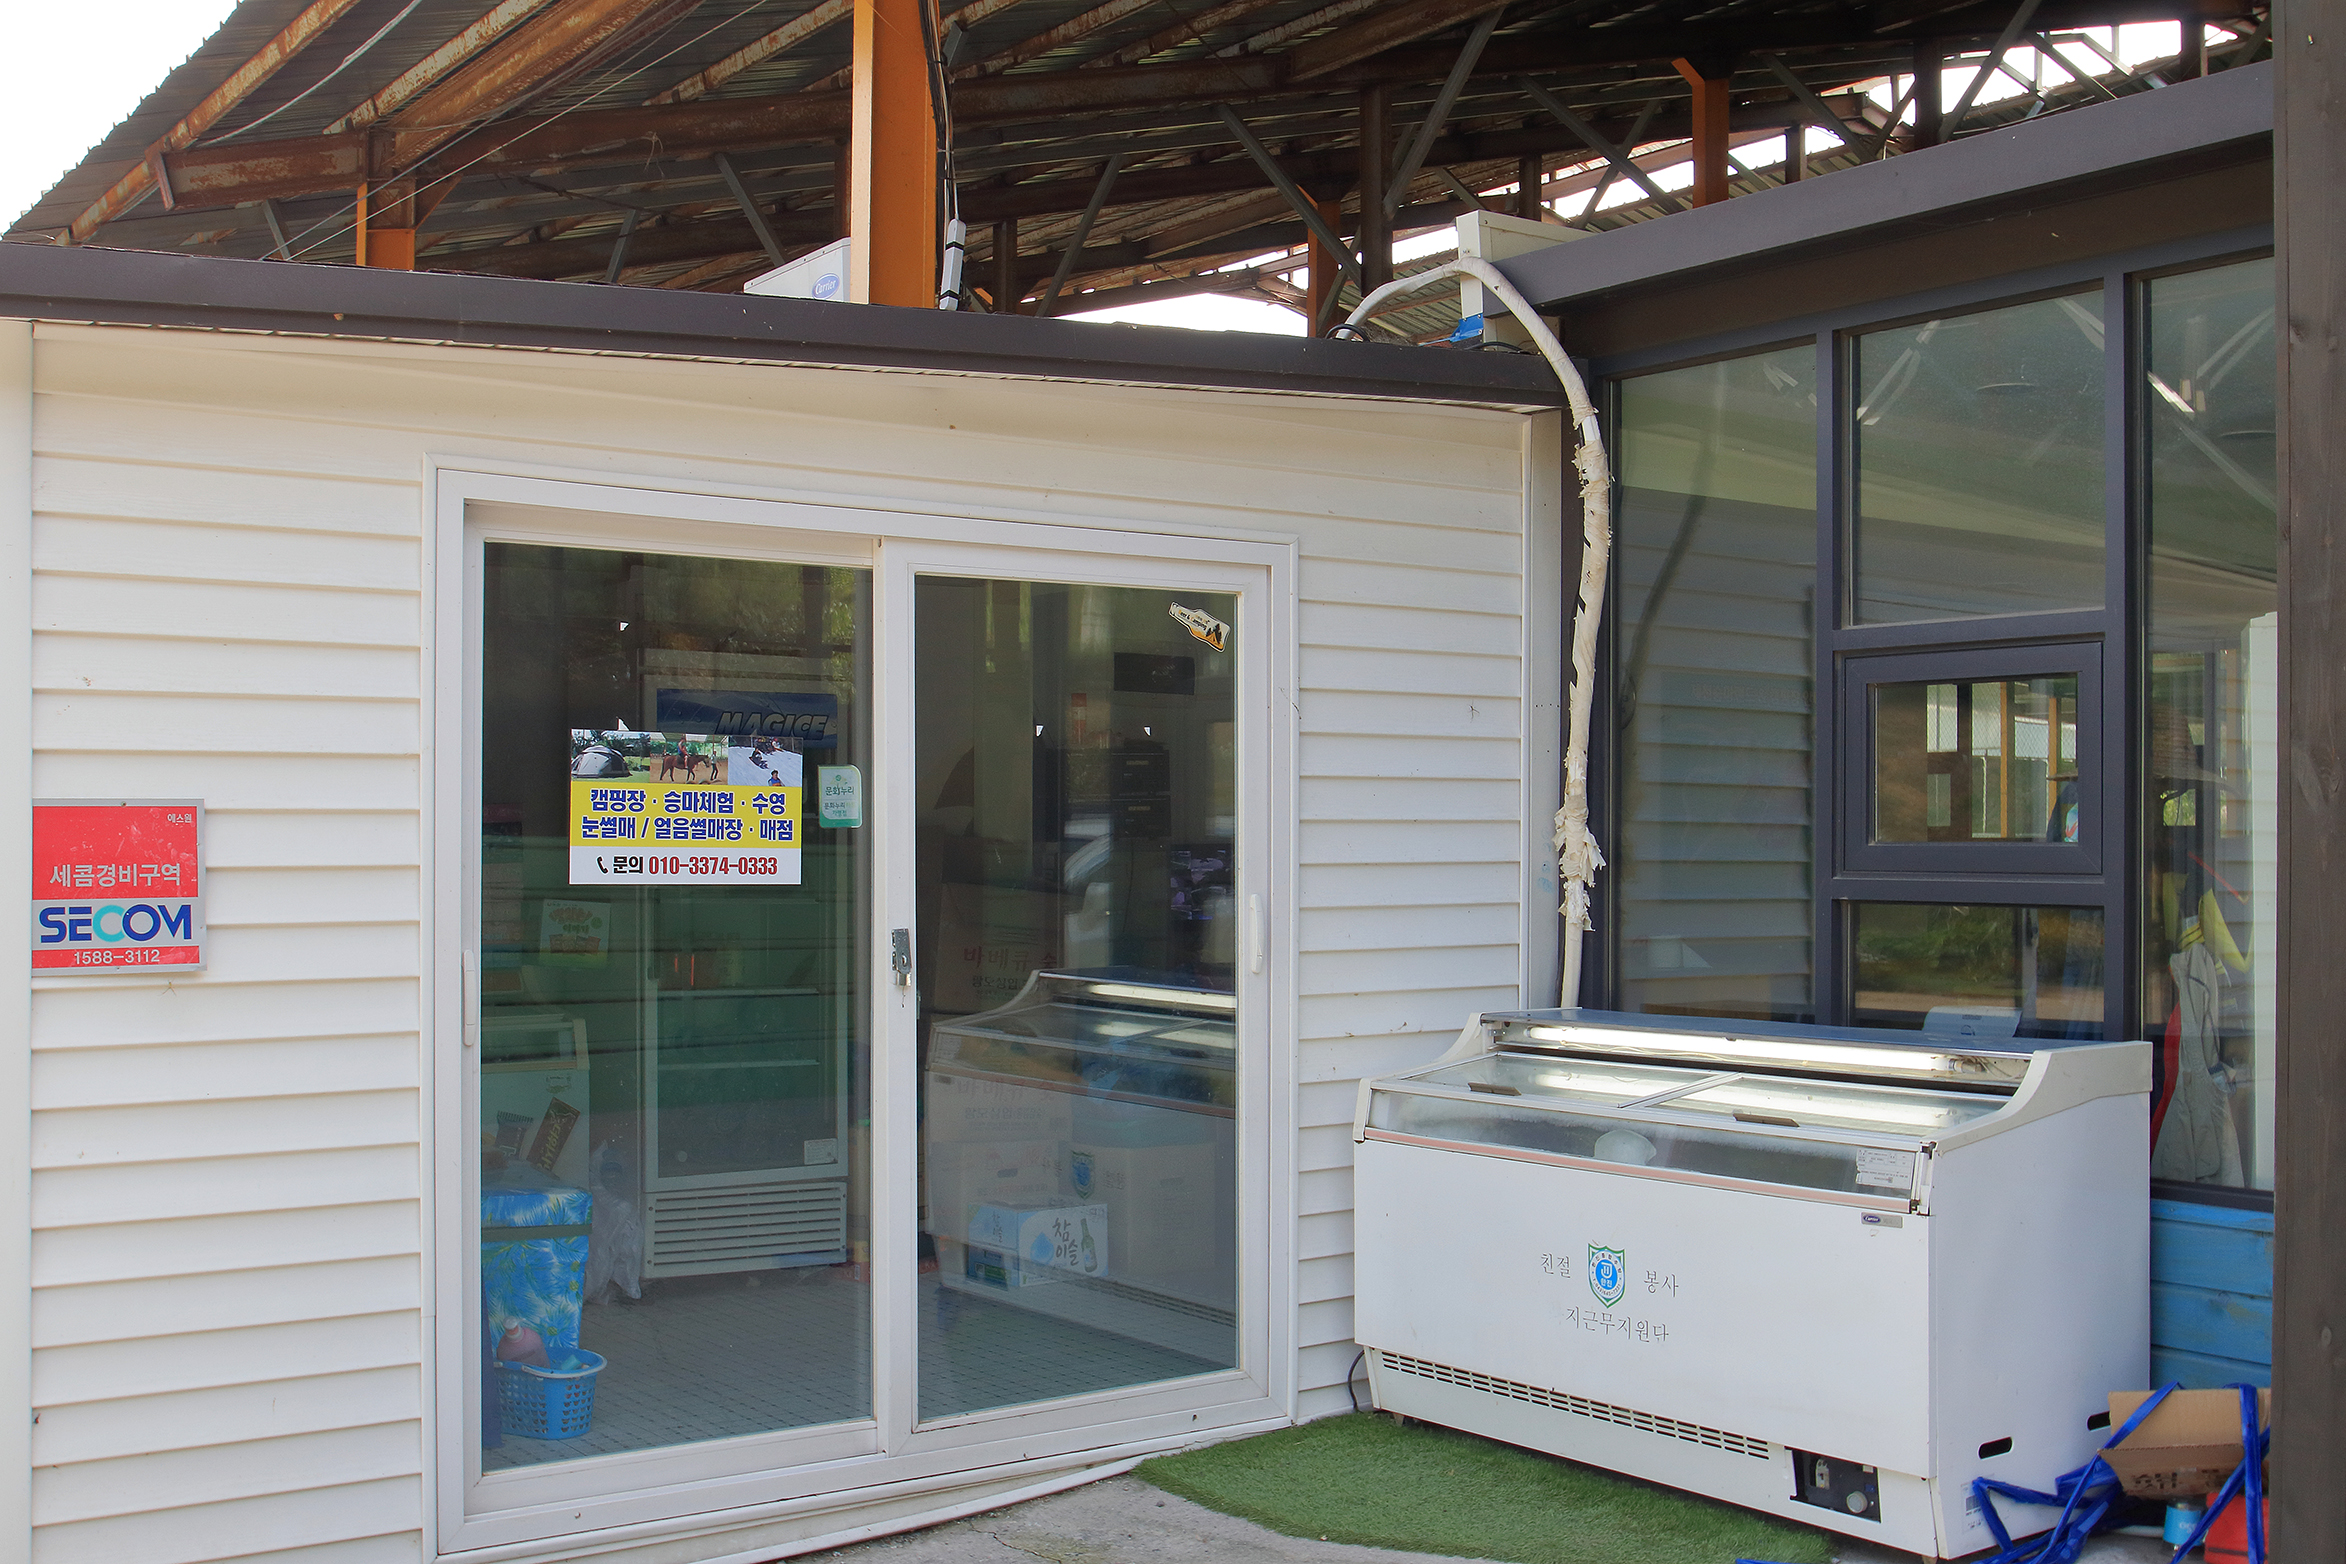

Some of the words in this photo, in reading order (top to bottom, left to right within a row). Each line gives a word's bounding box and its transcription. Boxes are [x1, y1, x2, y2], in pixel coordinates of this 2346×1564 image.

[815, 279, 837, 295] Carrier
[714, 711, 829, 741] MAGICE
[590, 788, 646, 813] 캠핑장
[664, 790, 734, 814] 승마체험
[752, 792, 786, 815] 수영
[825, 785, 855, 796] 문화누리
[581, 816, 635, 840] 눈썰매
[653, 818, 743, 841] 얼음썰매장
[759, 819, 793, 842] 매점
[49, 863, 181, 888] 세콤경비구역
[612, 855, 644, 875] 문의
[649, 855, 778, 876] 010-3374-0333
[38, 904, 193, 943] SECOM
[73, 949, 161, 965] 1588-3112
[1540, 1252, 1571, 1279] 친절
[1643, 1269, 1679, 1298] 봉사
